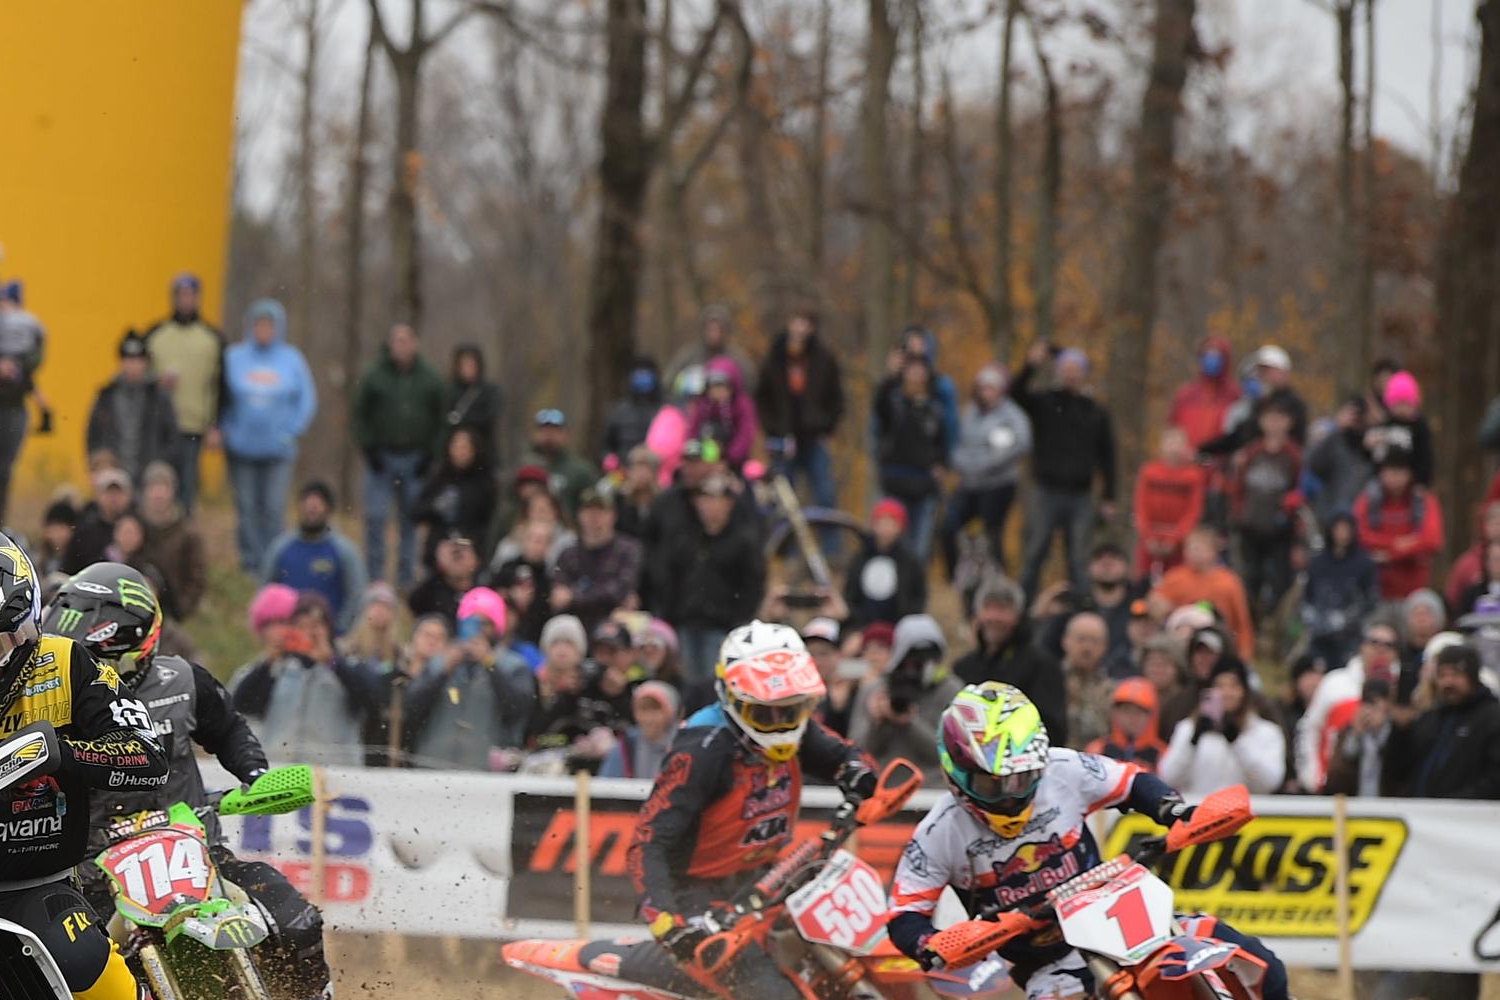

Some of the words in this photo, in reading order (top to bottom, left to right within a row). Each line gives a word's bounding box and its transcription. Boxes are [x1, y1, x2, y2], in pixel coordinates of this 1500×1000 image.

[117, 754, 149, 767] DRINK
[114, 837, 210, 907] 114
[996, 868, 1040, 905] Red
[1040, 851, 1080, 886] Bull
[62, 911, 92, 943] FLY
[812, 867, 890, 950] 530
[1106, 886, 1155, 951] 1
